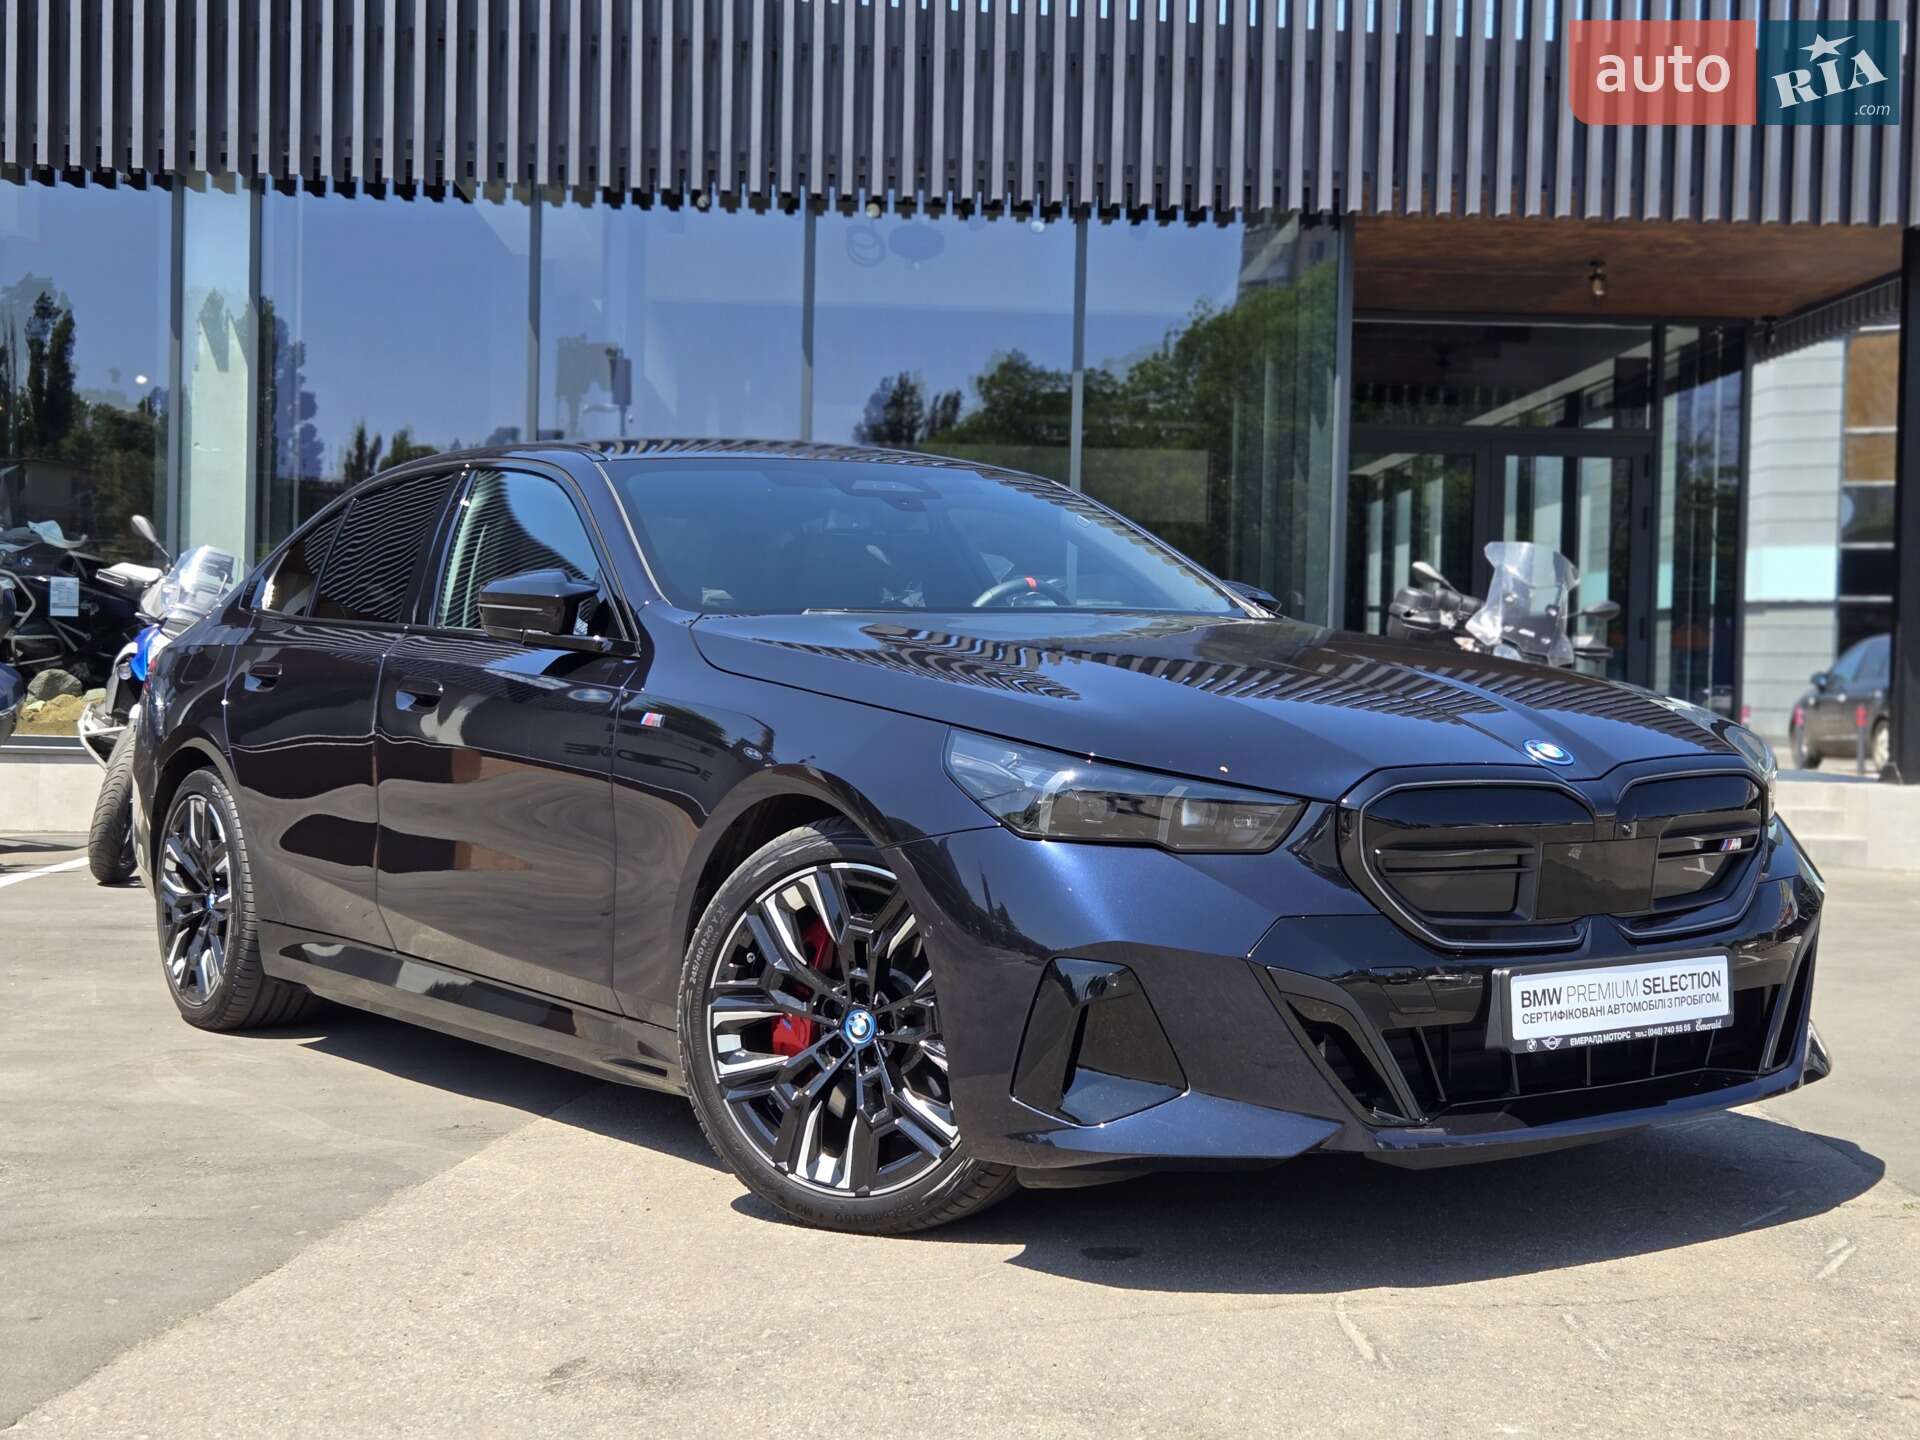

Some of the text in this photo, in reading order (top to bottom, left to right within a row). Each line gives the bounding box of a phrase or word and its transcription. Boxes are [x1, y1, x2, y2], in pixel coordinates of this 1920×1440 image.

[1521, 970, 1721, 1008] BMW PREMIUM SELECTION
[1522, 1005, 1605, 1024] СЕРТИФІКОВАНІ
[1607, 998, 1666, 1015] АВТОМОБІЛІ
[1570, 1034, 1603, 1047] ЕМЕРАЛД
[1603, 1031, 1631, 1043] МОТОРС
